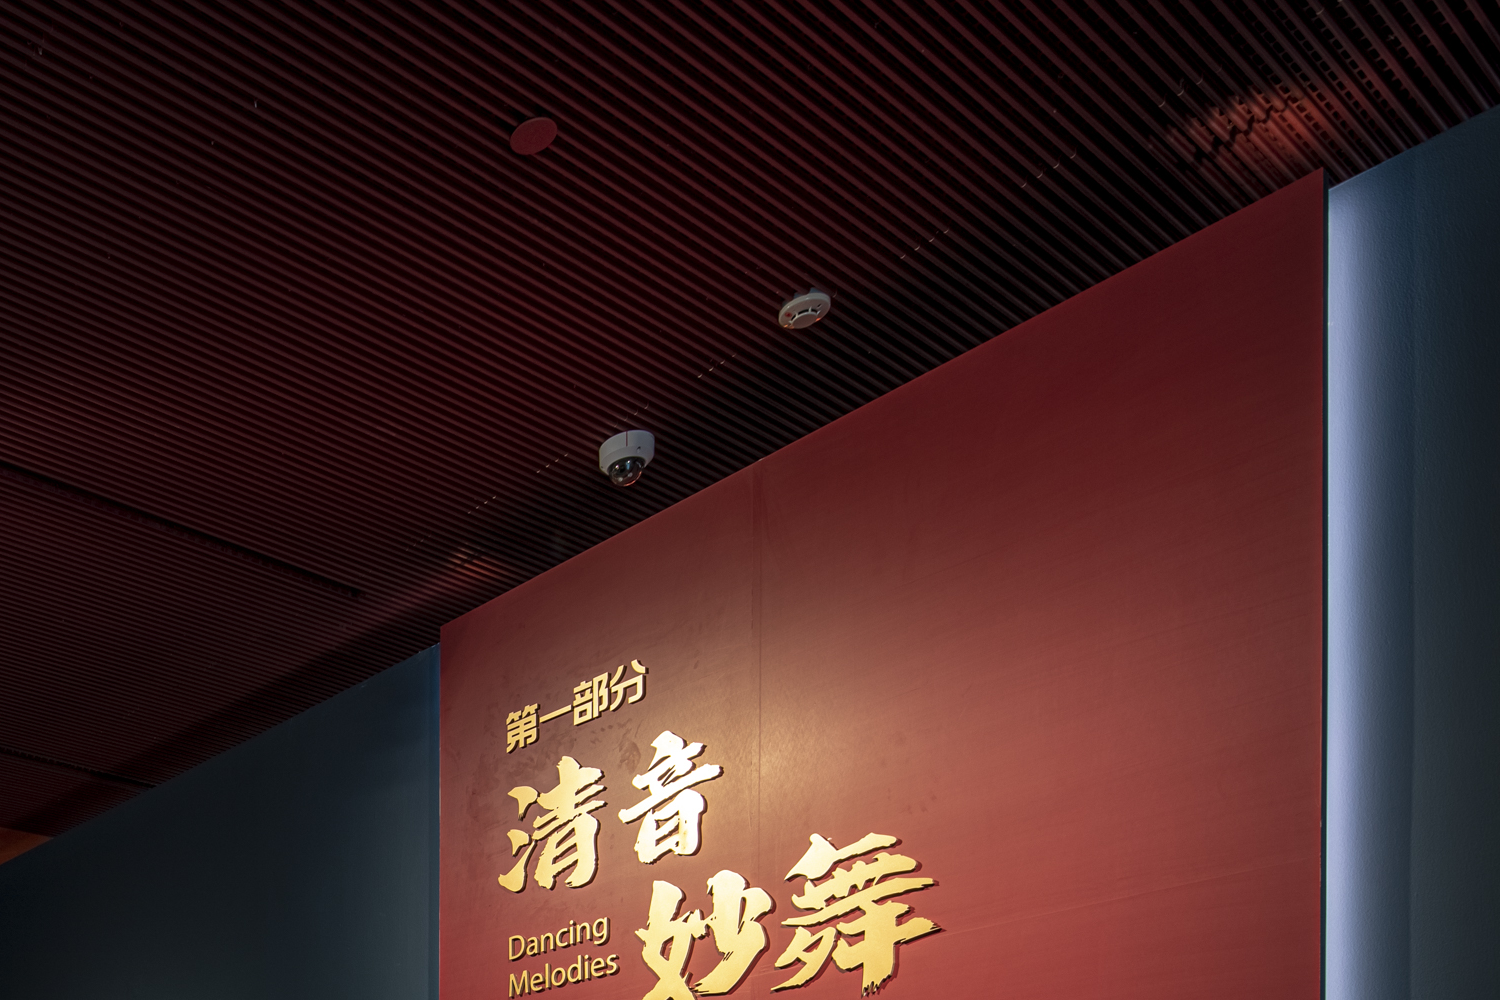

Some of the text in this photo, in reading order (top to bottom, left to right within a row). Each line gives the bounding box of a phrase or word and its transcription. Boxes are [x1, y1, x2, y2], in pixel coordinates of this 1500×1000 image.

[506, 658, 647, 753] 第一部分
[498, 730, 723, 892] 清音
[507, 916, 610, 962] Dancing
[507, 951, 618, 998] Melodies
